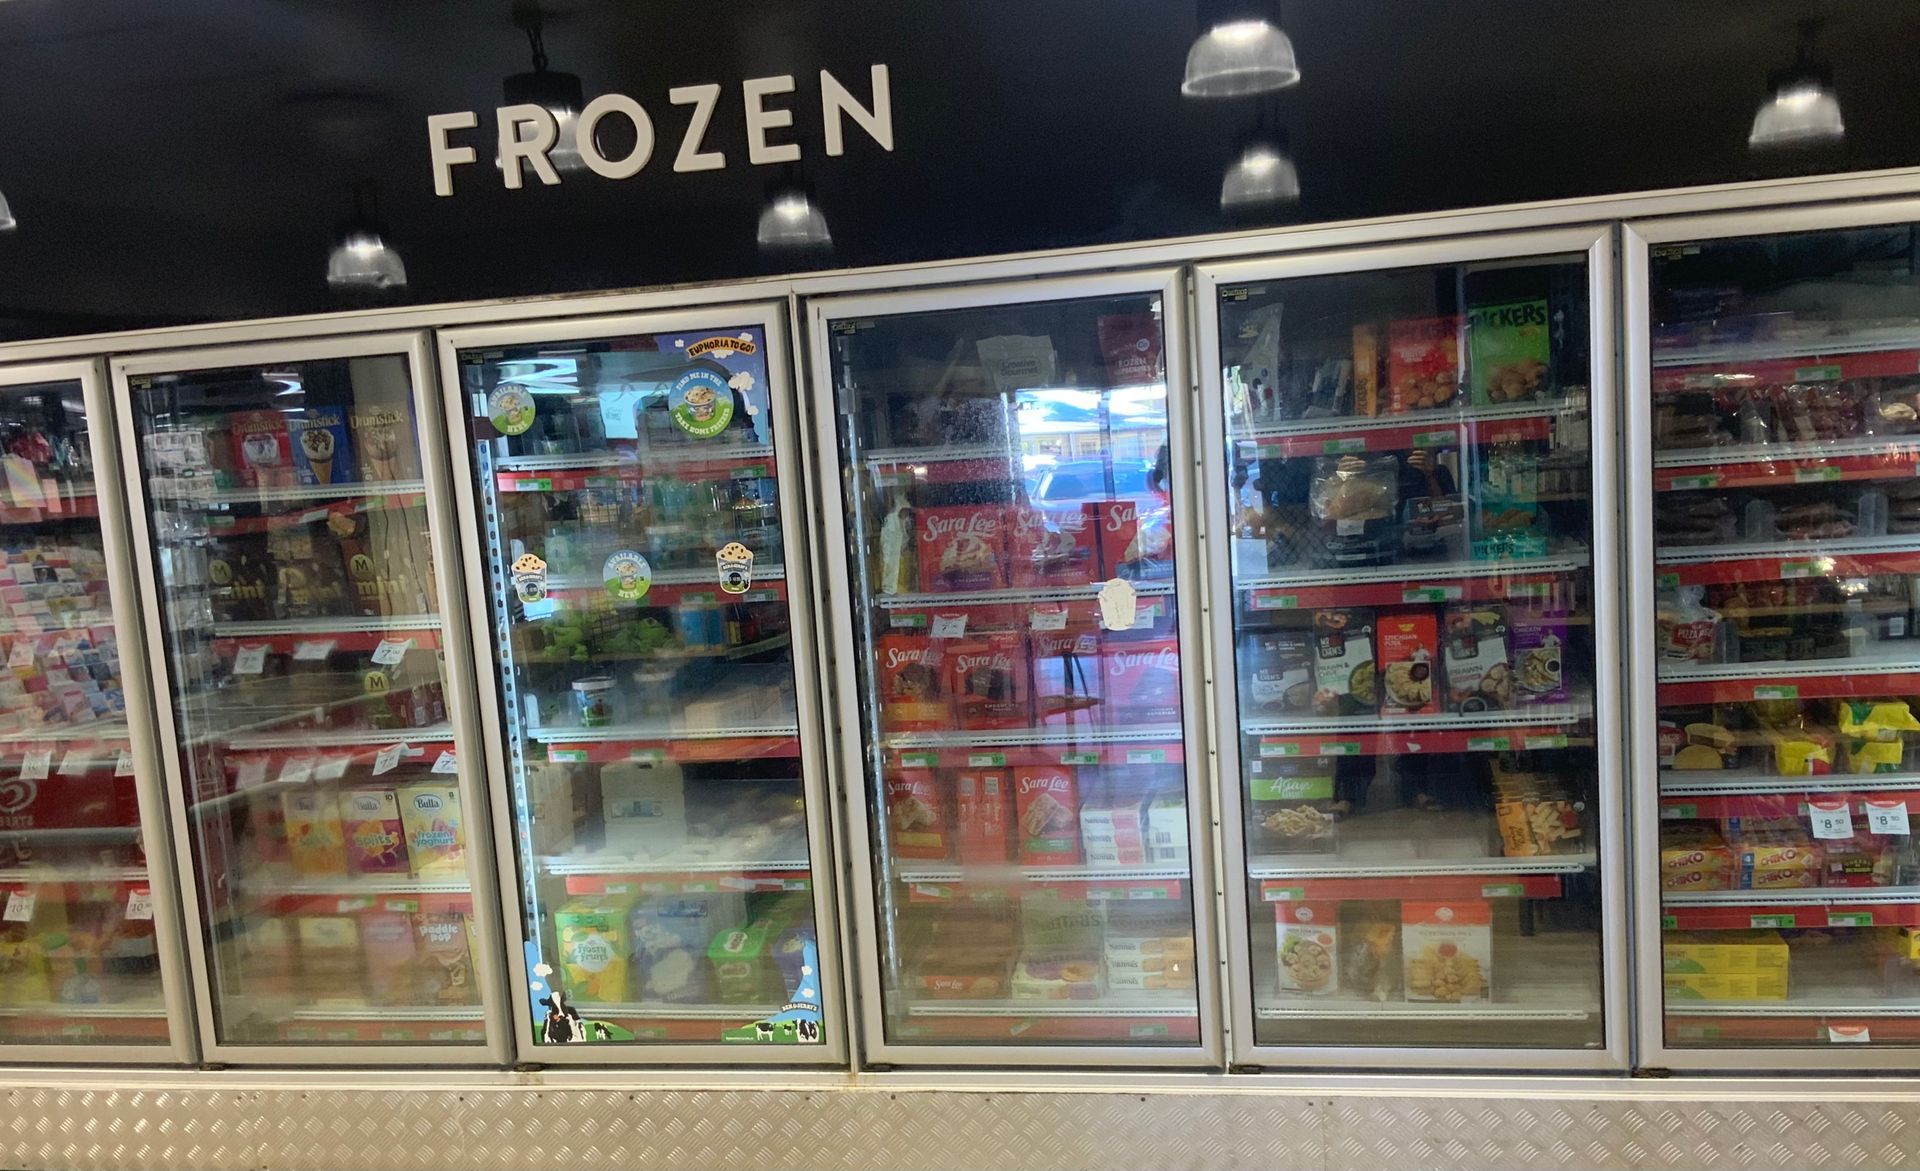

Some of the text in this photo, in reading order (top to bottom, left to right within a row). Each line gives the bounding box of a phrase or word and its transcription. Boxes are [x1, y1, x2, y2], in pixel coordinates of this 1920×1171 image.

[427, 63, 895, 197] FROZEN
[688, 338, 754, 356] EUPHORIA TO GO!
[675, 371, 722, 390] FIND ME IN THE
[490, 385, 530, 406] AVAILABLE
[231, 418, 285, 436] Drumstick
[288, 413, 342, 433] Drumstick
[351, 411, 404, 430] Drumstick
[507, 420, 529, 433] HERE
[674, 407, 730, 435] TAKE HOME FREEZER
[923, 512, 997, 542] Sara Lee
[607, 552, 647, 569] AVAILABLE
[357, 574, 408, 596] mini
[617, 589, 640, 599] HERE
[1677, 629, 1698, 640] PIZZA
[1037, 634, 1098, 656] Sara Lee
[886, 647, 919, 670] Sara
[956, 652, 1014, 673] Sara Lee
[1110, 650, 1153, 676] Sara
[888, 779, 911, 794] Sara
[1020, 775, 1069, 795] Sara Lee
[416, 797, 440, 809] Bulla
[356, 832, 392, 849] splits
[415, 837, 456, 849] yoghurt
[417, 830, 454, 840] frozen
[1668, 851, 1704, 868] CHIKO
[1760, 849, 1797, 866] CHIKO
[1667, 871, 1703, 888] CHIKO
[1758, 869, 1794, 885] CHIKO
[419, 923, 459, 937] paddle
[430, 932, 452, 943] pop
[933, 977, 952, 991] Sara
